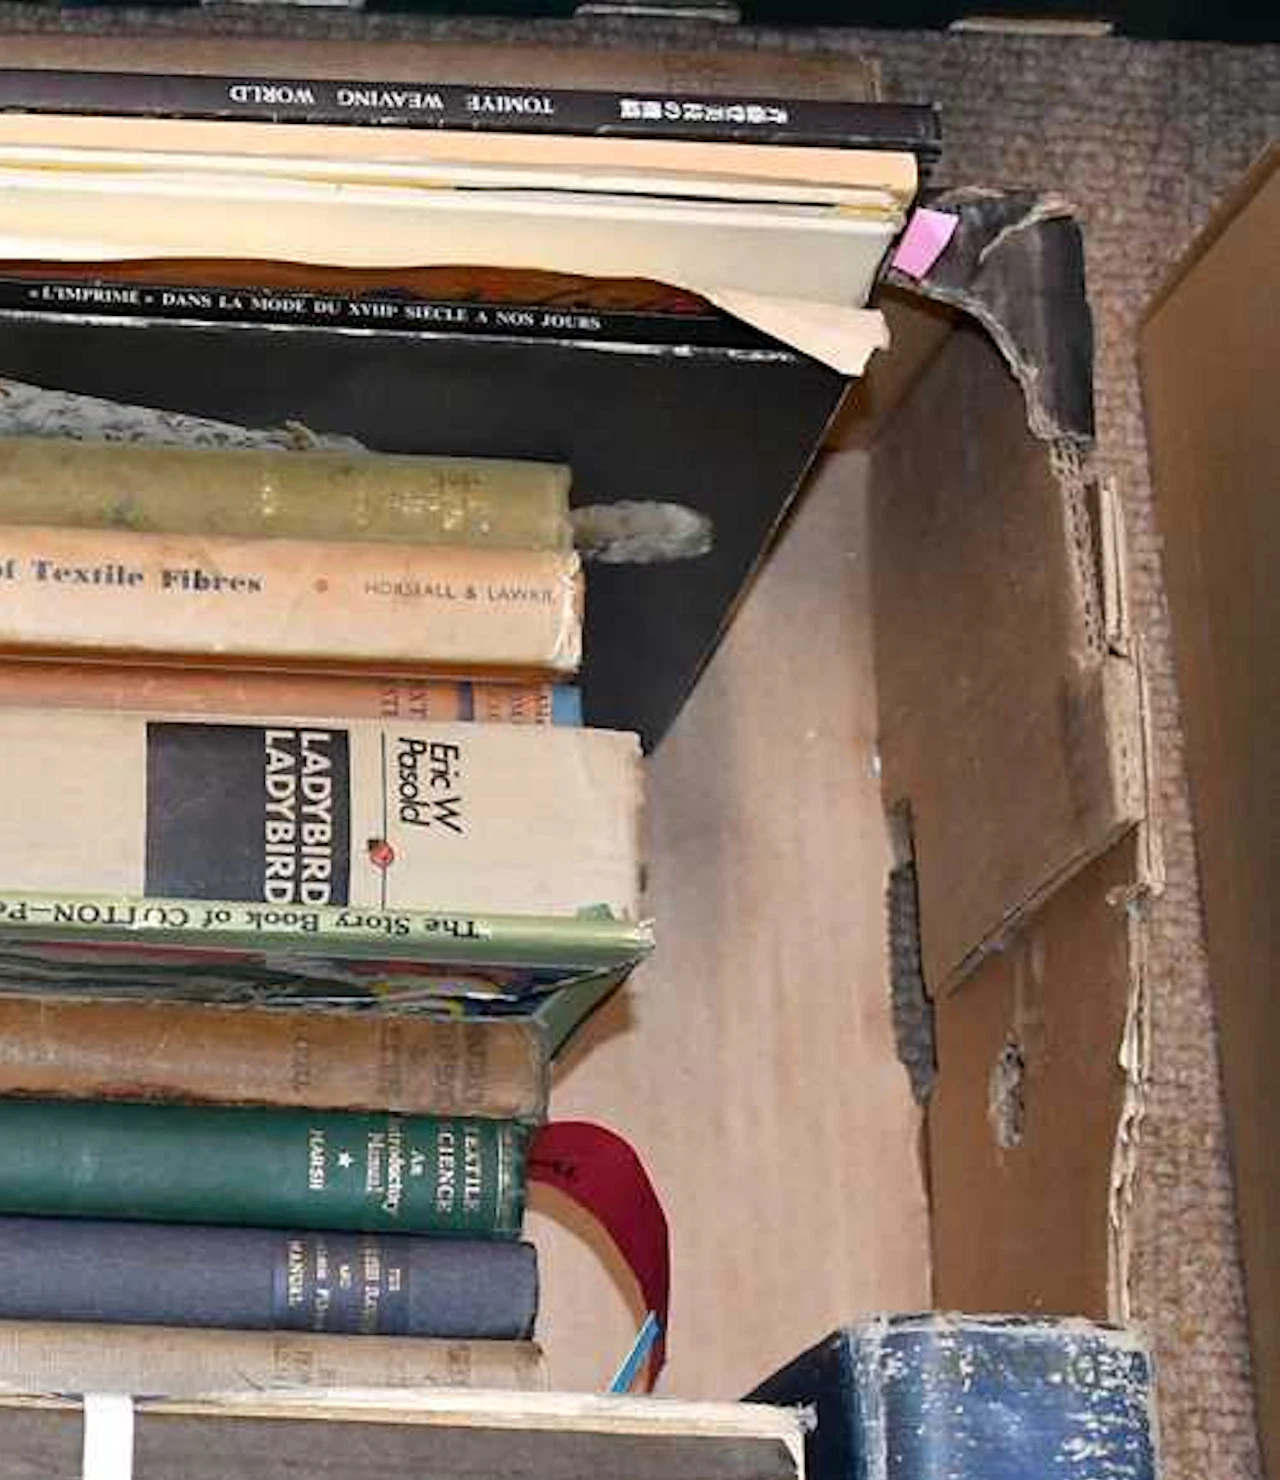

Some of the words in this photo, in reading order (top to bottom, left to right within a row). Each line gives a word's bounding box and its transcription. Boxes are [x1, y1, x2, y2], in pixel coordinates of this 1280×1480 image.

[228, 83, 315, 107] WORLD
[336, 88, 444, 113] WEAVING
[464, 94, 555, 116] TOMIYE
[161, 291, 213, 310] DANS
[219, 294, 242, 311] LA
[251, 296, 307, 314] MODE
[314, 299, 341, 315] DU
[494, 309, 532, 328] NOS
[539, 311, 600, 332] JOURS
[29, 558, 145, 588] Textile
[161, 567, 264, 593] Fibres
[428, 741, 461, 790] Eric
[397, 736, 431, 828] Pasold
[264, 729, 298, 903] LADYBIRD
[299, 730, 333, 905] LADYBIRD
[433, 796, 465, 835] W
[204, 906, 231, 930] of
[244, 909, 320, 933] Book
[336, 909, 411, 936] Story
[424, 916, 480, 940] The
